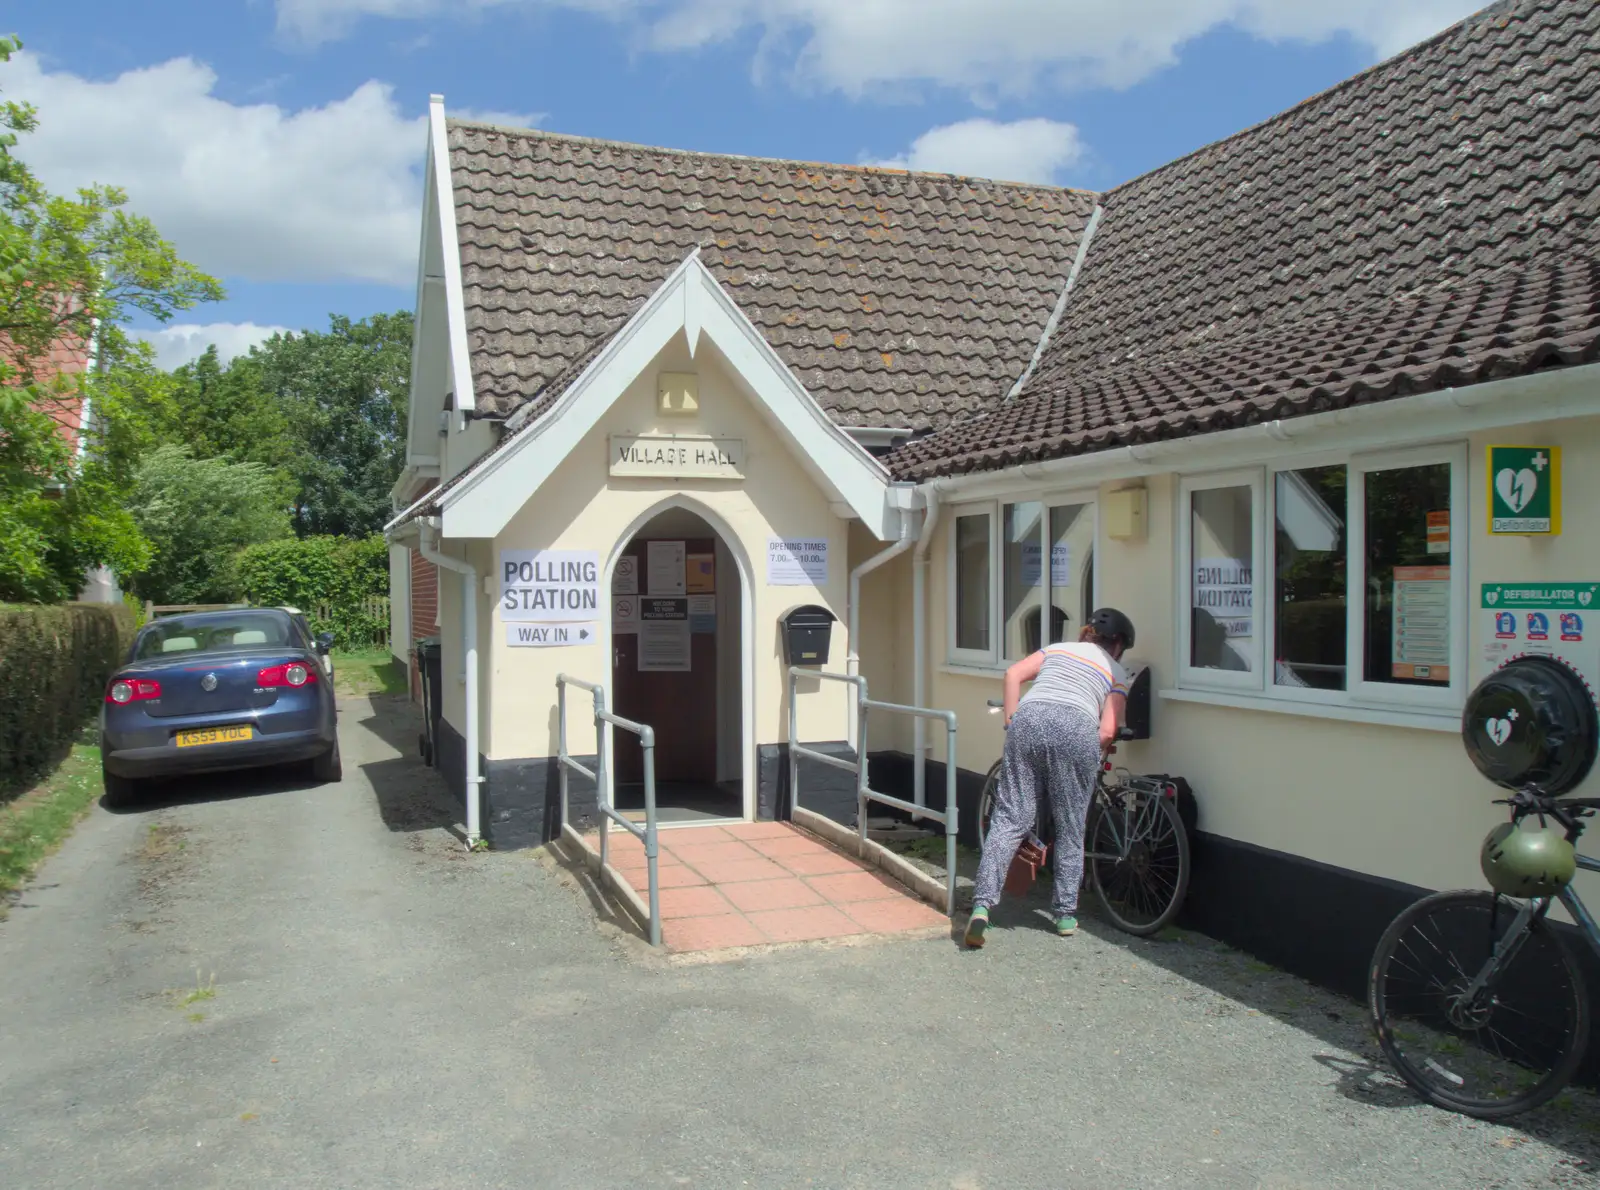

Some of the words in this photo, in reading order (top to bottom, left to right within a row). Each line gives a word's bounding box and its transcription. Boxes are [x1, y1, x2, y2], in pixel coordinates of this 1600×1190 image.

[619, 447, 686, 465] VILLAGE
[696, 449, 736, 465] HALL
[769, 542, 802, 551] OPENING
[804, 543, 827, 551] TIMES
[504, 561, 596, 582] POLLING
[504, 588, 596, 610] STATION
[1503, 589, 1575, 599] DEFIBRILLATOR
[518, 628, 549, 642] WAY
[554, 628, 568, 642] IN
[183, 729, 216, 745] KS59
